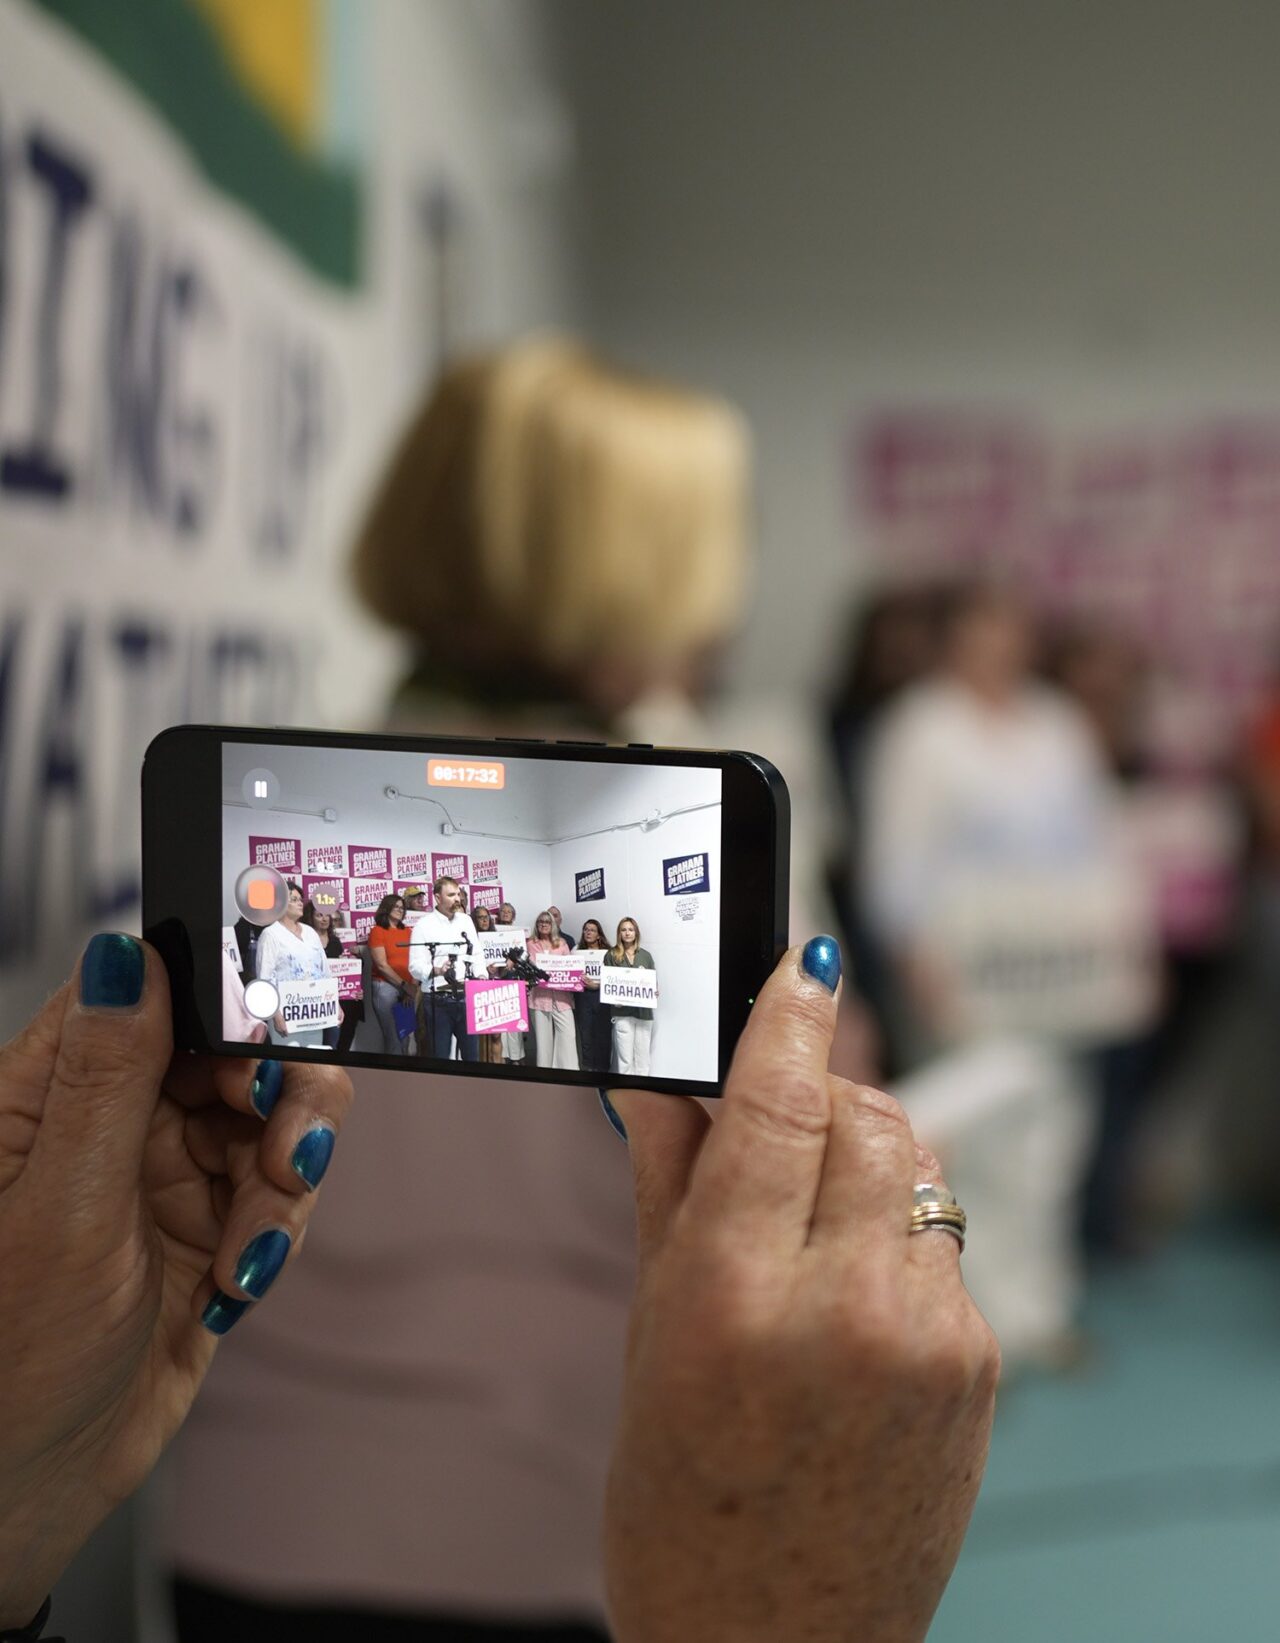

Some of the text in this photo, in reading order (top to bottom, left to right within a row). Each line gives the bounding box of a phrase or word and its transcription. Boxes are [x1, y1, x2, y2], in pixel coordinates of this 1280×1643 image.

[433, 766, 498, 783] 00:17:32
[255, 841, 296, 855] GRAHAM
[307, 846, 343, 858] GRAHAM
[256, 851, 296, 865] PLATNER
[307, 855, 343, 868] PLATNER
[353, 849, 387, 863] GRAHAM
[397, 854, 427, 866] GRAHAM
[435, 857, 464, 869] GRAHAM
[354, 860, 387, 874] PLATNER
[397, 863, 427, 874] PLATNER
[436, 865, 465, 878] PLATNER
[472, 860, 498, 871] GRAHAM
[668, 855, 704, 878] GRAHAM
[473, 868, 498, 879] PLATNER
[578, 870, 601, 888] GRAHAM
[668, 866, 705, 888] PLATNER
[308, 879, 344, 893] GRAM
[355, 882, 388, 896] GRAHAM
[579, 878, 602, 896] PLATNER
[316, 893, 336, 905] 1.1x
[474, 888, 500, 900] GRAHAM
[474, 983, 519, 1008] GRAHAM
[604, 983, 654, 999] GRAHAM
[286, 992, 323, 1005] Women
[283, 1001, 337, 1021] GRAHAM
[474, 997, 520, 1023] PLATNER
